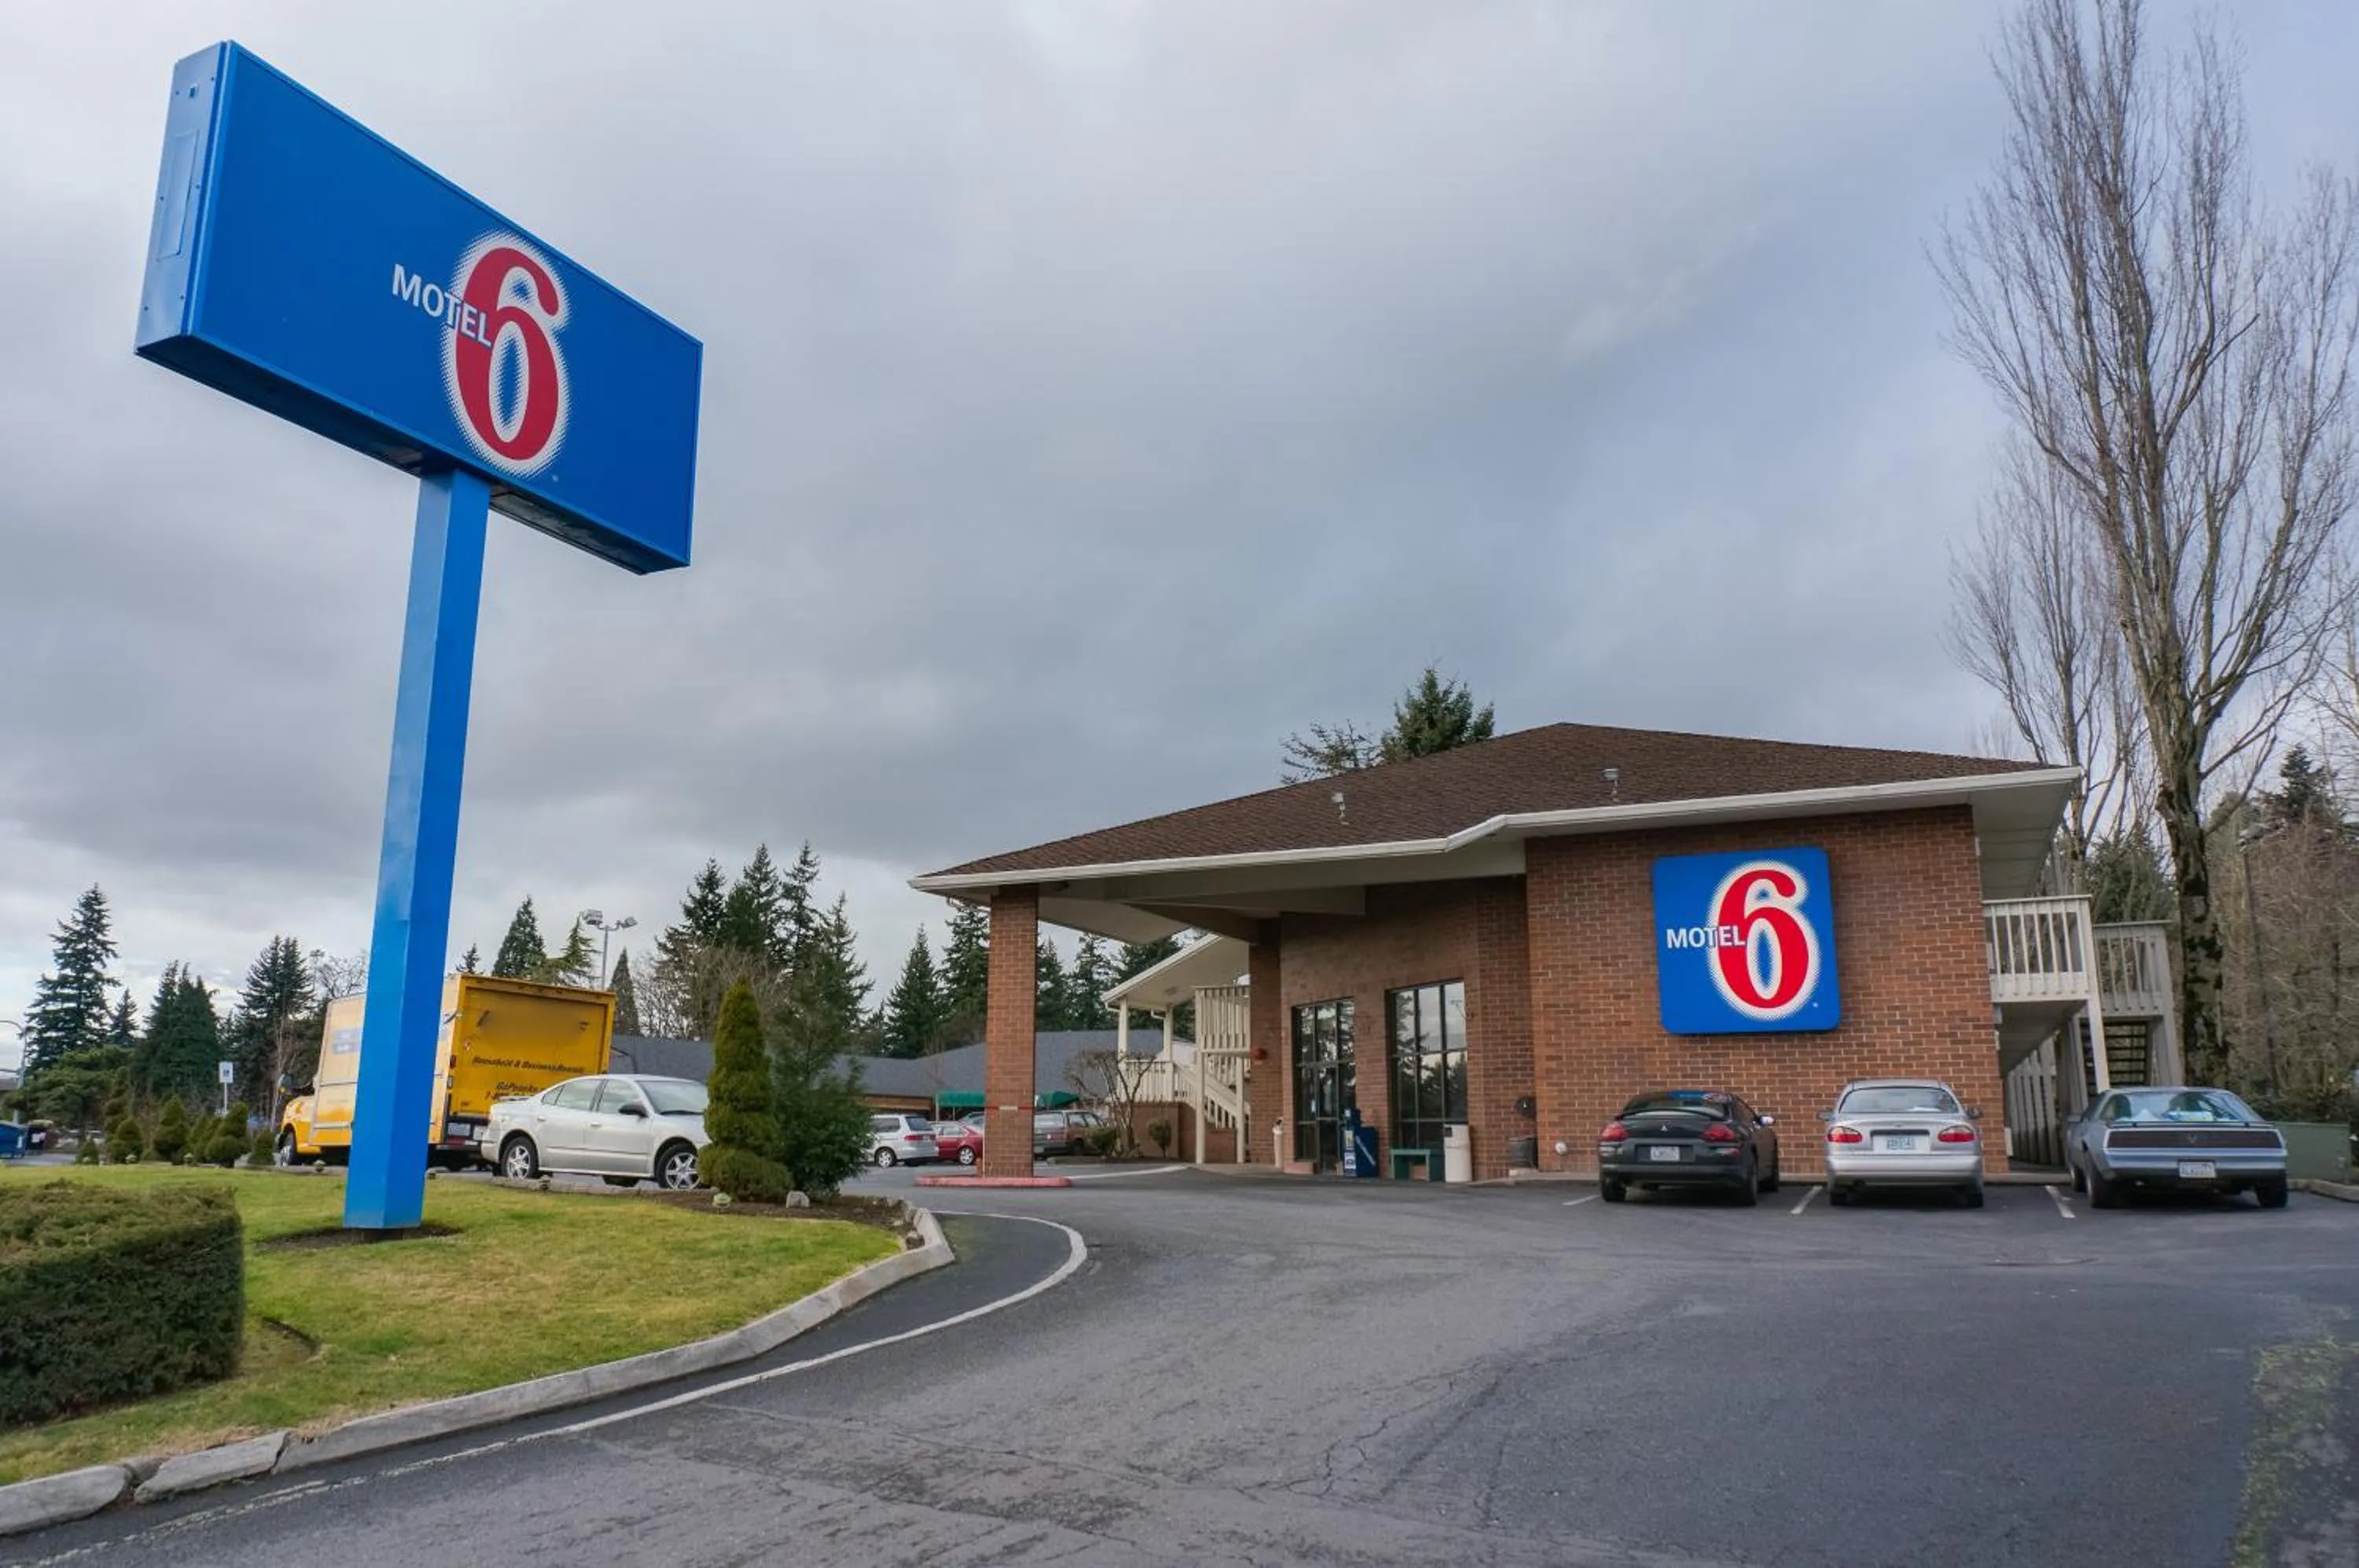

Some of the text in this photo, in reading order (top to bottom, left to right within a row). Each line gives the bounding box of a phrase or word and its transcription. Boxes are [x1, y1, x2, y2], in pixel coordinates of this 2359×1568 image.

[392, 246, 559, 461] MOTEL 6
[1665, 870, 1809, 1009] MOTEL 6
